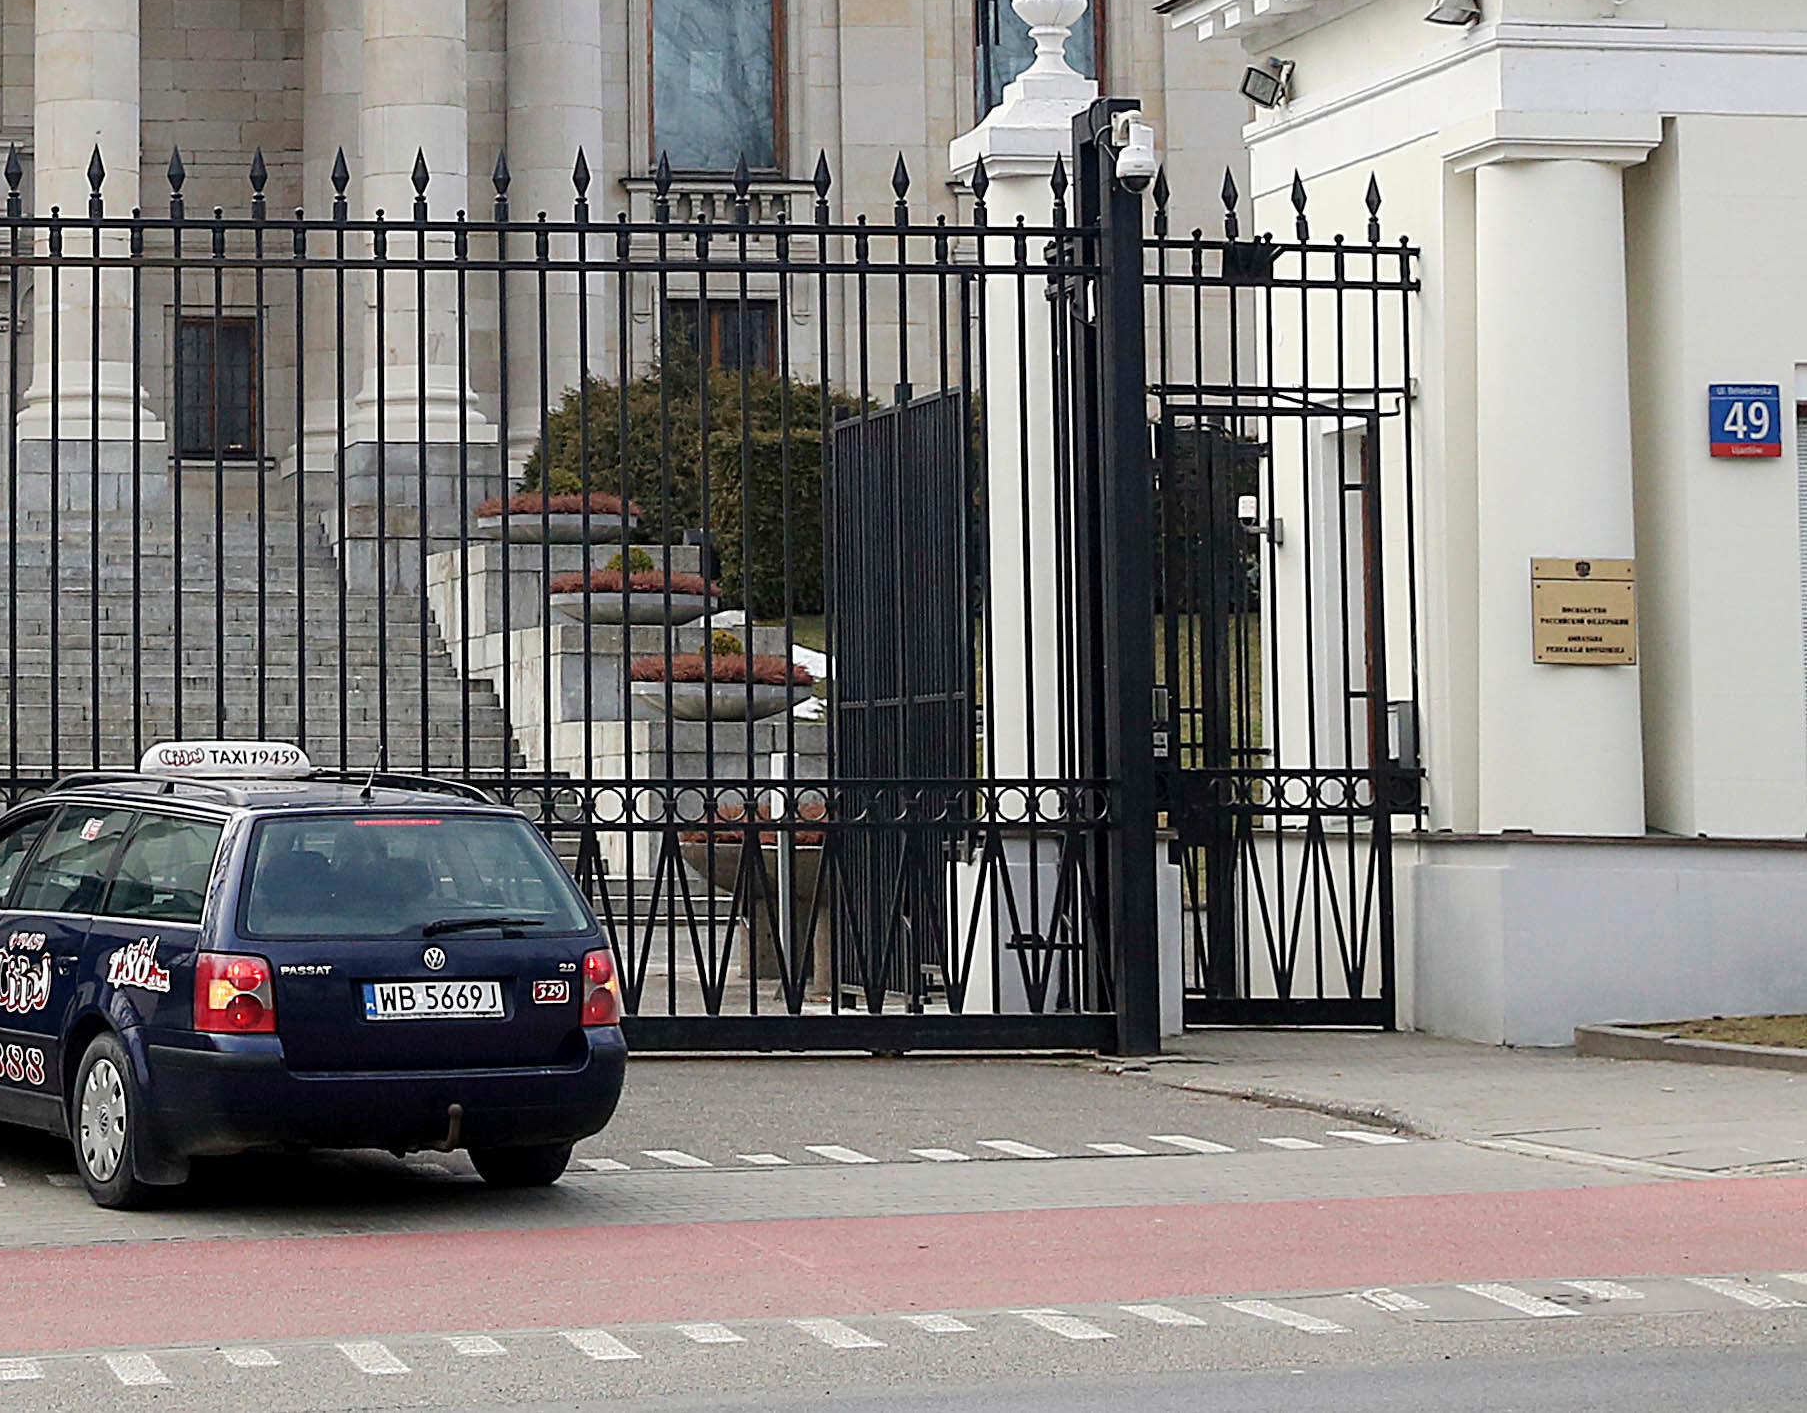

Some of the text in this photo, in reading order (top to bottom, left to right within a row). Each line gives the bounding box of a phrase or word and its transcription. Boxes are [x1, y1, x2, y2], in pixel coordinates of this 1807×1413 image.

[1724, 401, 1770, 440] 49
[209, 750, 248, 765] TAXI
[250, 750, 300, 765] 19459
[280, 965, 332, 976] PASSAT
[379, 984, 497, 1012] WB 5669J
[537, 983, 565, 999] 329
